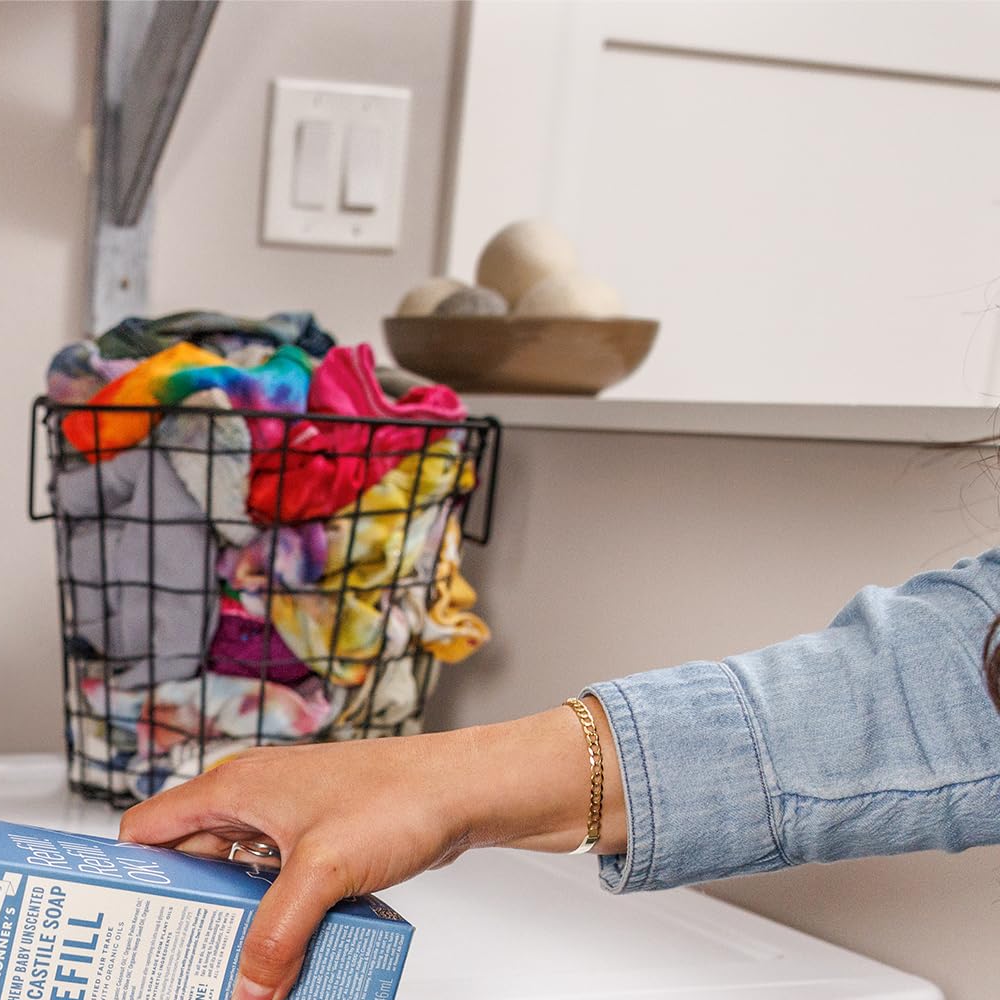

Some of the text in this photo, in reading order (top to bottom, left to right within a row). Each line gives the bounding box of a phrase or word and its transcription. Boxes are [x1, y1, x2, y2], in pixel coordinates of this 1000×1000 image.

[116, 857, 171, 884] OK!
[20, 886, 45, 944] UNSCENTED
[42, 885, 68, 929] SOAP
[14, 946, 31, 972] BABY
[96, 956, 106, 975] FAIR
[102, 926, 113, 953] TRADE
[104, 943, 119, 980] ORGANIC
[114, 921, 124, 940] OILS
